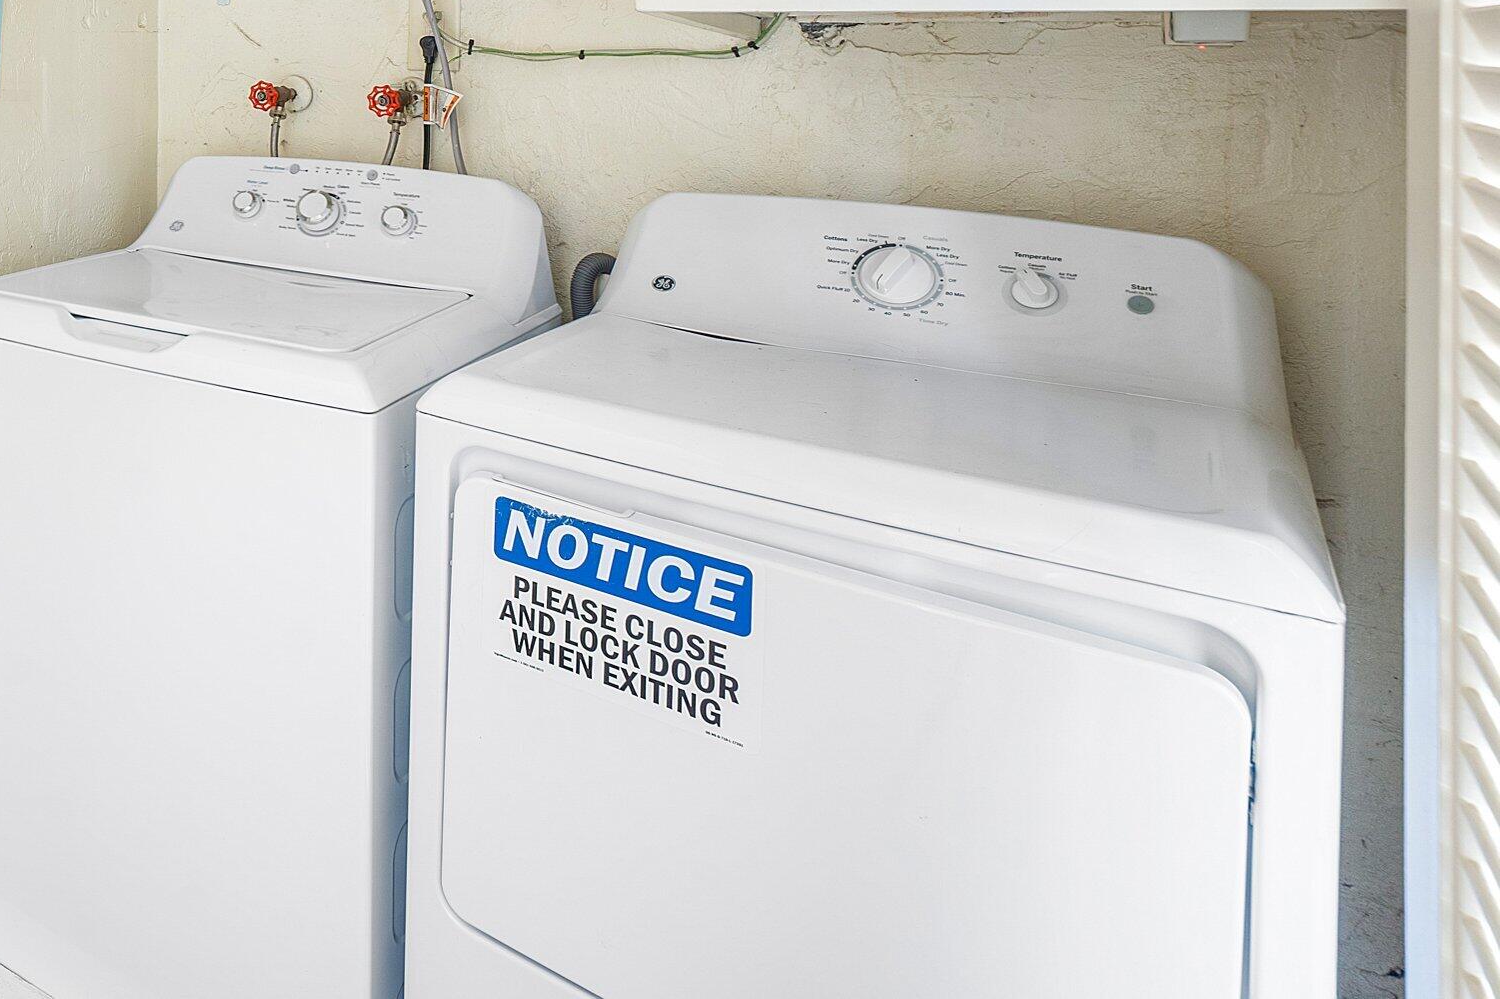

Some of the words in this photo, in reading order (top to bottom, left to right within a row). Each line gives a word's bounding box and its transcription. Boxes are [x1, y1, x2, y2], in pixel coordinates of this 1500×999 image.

[823, 234, 848, 242] Cottons
[1013, 251, 1063, 262] Temperature
[1130, 283, 1152, 292] Start
[503, 508, 746, 622] NOTICE
[499, 599, 556, 637] AND
[564, 620, 641, 669] LOCK
[649, 649, 740, 705] DOOR
[513, 575, 618, 633] PLEASE
[625, 614, 728, 670] CLOSE
[511, 628, 593, 680] WHEN
[603, 661, 722, 728] EXITING
